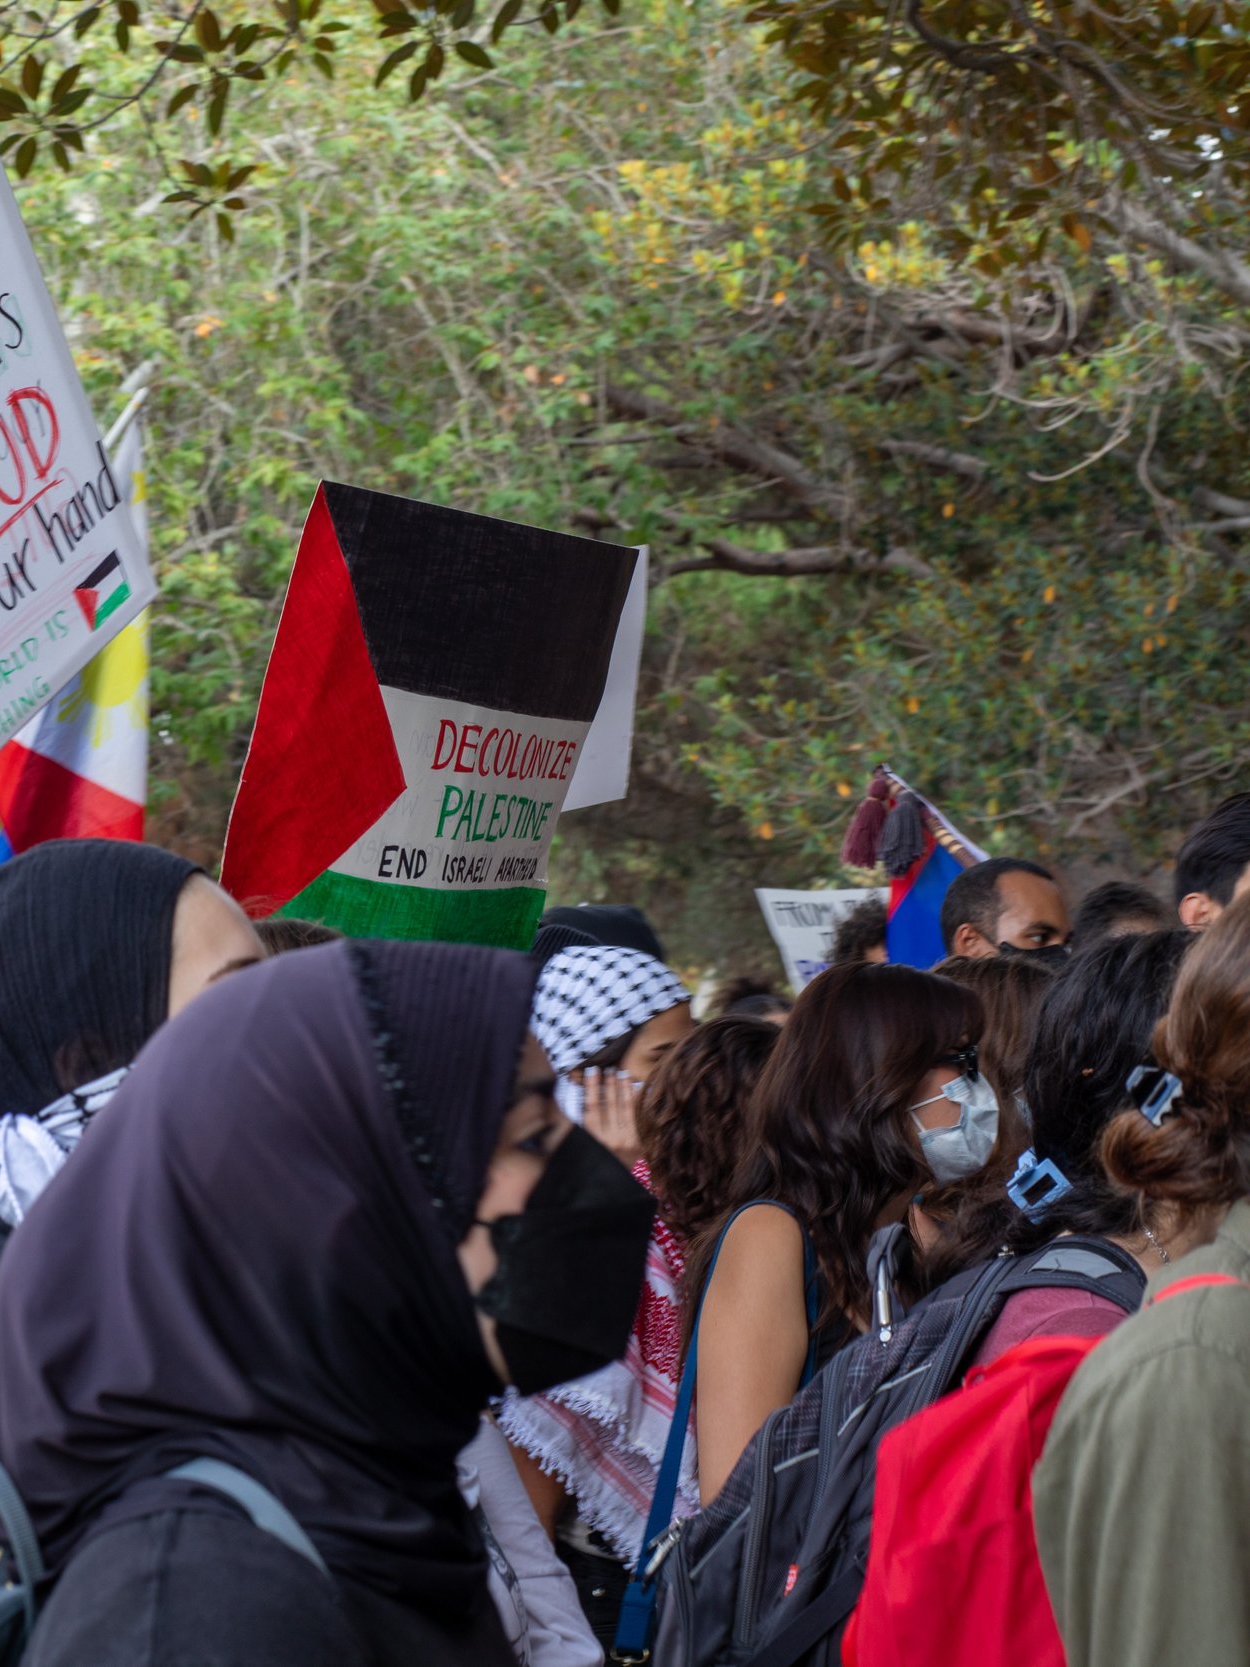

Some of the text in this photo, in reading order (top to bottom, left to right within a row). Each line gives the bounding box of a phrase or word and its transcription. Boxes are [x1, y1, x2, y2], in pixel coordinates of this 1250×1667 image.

[31, 440, 122, 564] hand
[45, 609, 70, 641] IS
[430, 719, 576, 780] DECOLONIZE
[434, 785, 553, 842] PALESTINE
[378, 845, 427, 879] END
[441, 854, 493, 883] ISRAELI
